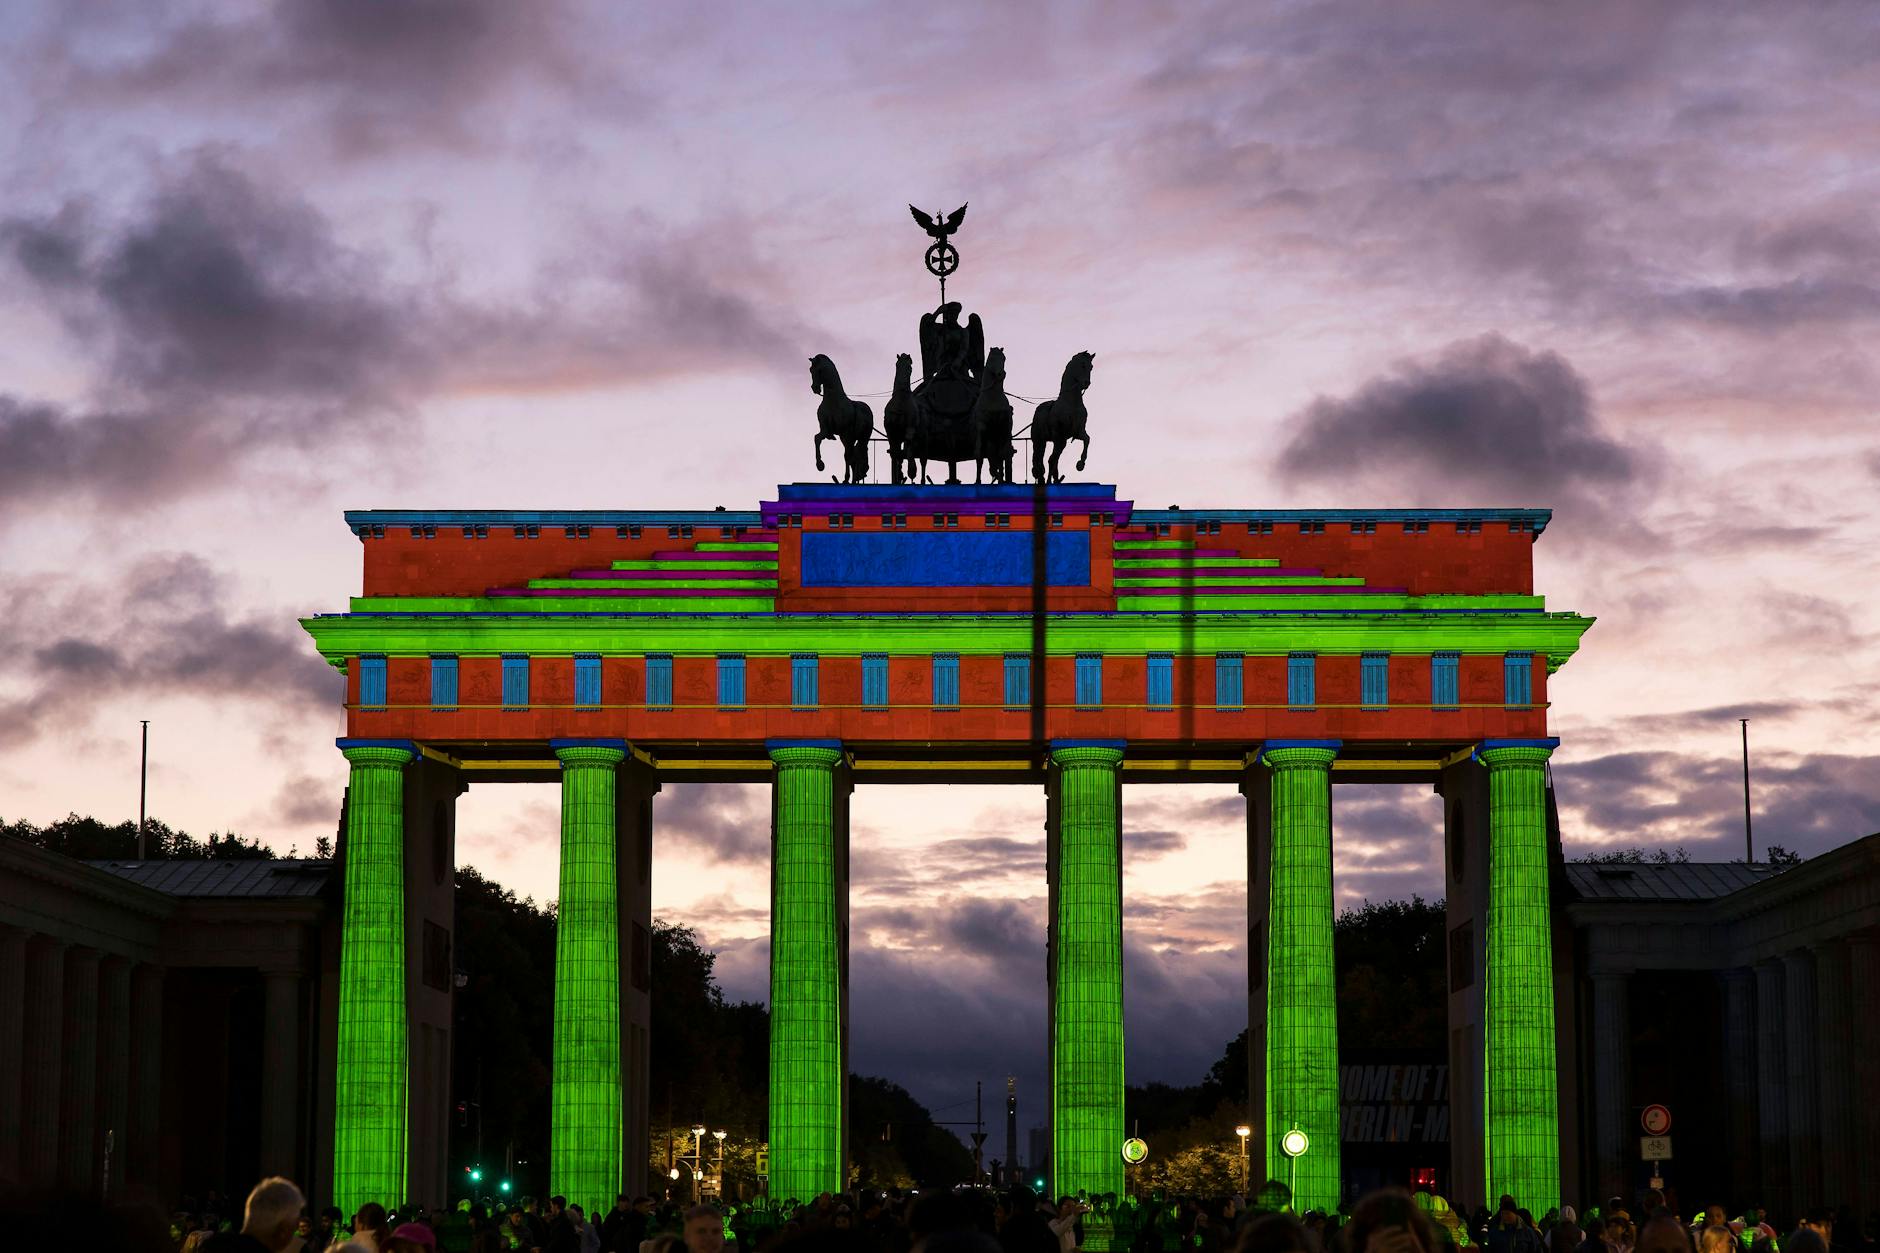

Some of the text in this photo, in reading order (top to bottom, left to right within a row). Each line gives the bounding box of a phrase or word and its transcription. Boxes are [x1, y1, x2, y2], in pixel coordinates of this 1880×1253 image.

[1400, 1065, 1432, 1101] OF
[1431, 1065, 1448, 1101] T
[1340, 1105, 1449, 1142] ERLIN-M
